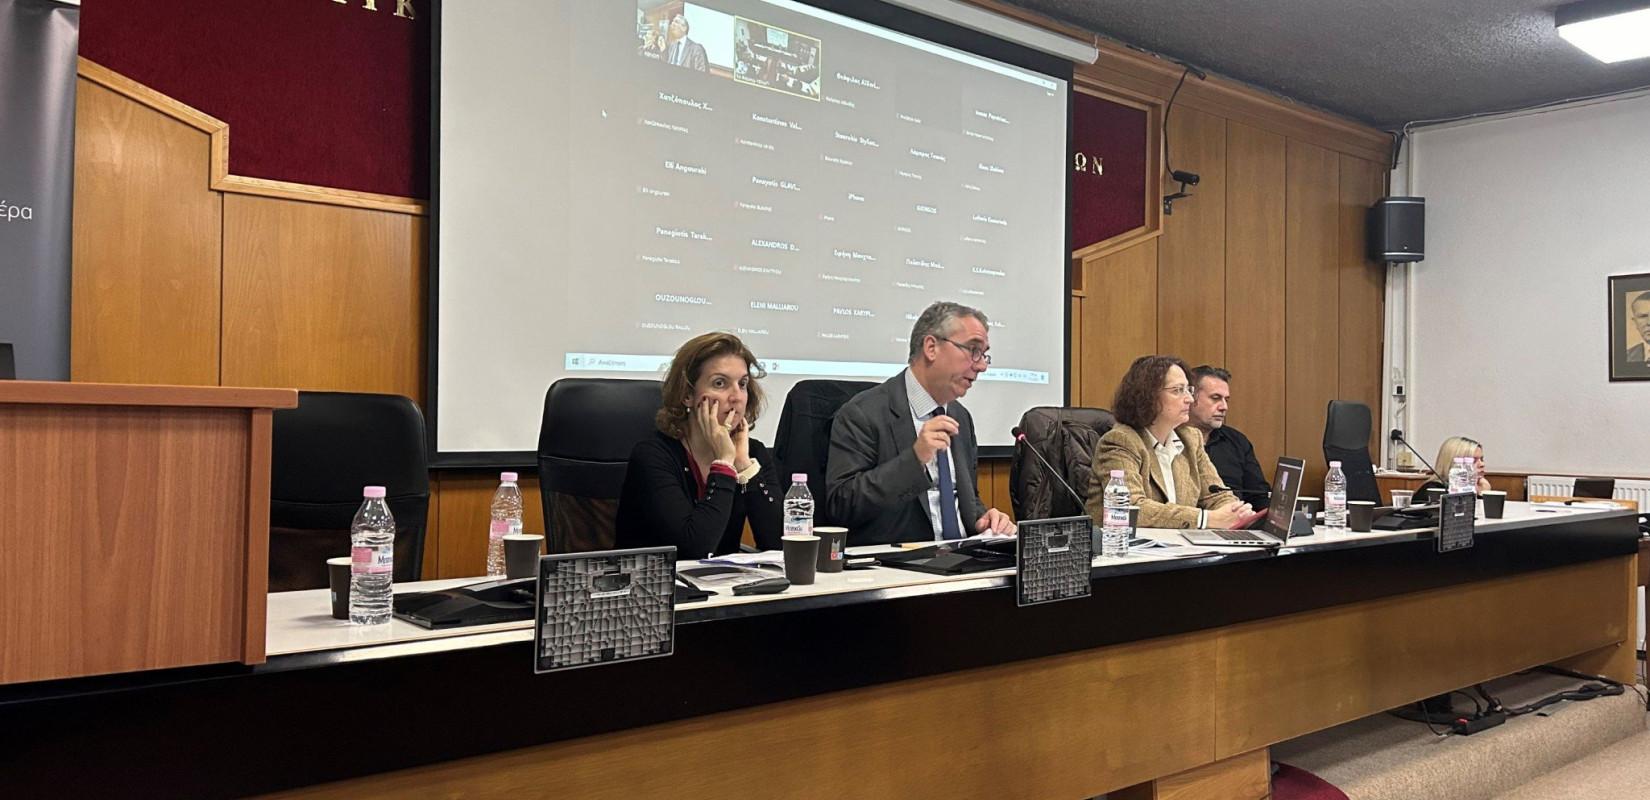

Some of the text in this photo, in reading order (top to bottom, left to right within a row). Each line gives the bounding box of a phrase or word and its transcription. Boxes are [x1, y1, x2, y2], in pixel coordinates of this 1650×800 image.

[752, 113, 787, 128] Konstantinos
[675, 162, 707, 175] Angouraki
[656, 227, 688, 239] Panagiotis
[751, 239, 788, 251] ALEXANDROS
[655, 293, 713, 306] OUZOUNOGLOU...
[750, 301, 799, 312] ELENI MALLIAROU
[833, 307, 852, 316] PAVLOS
